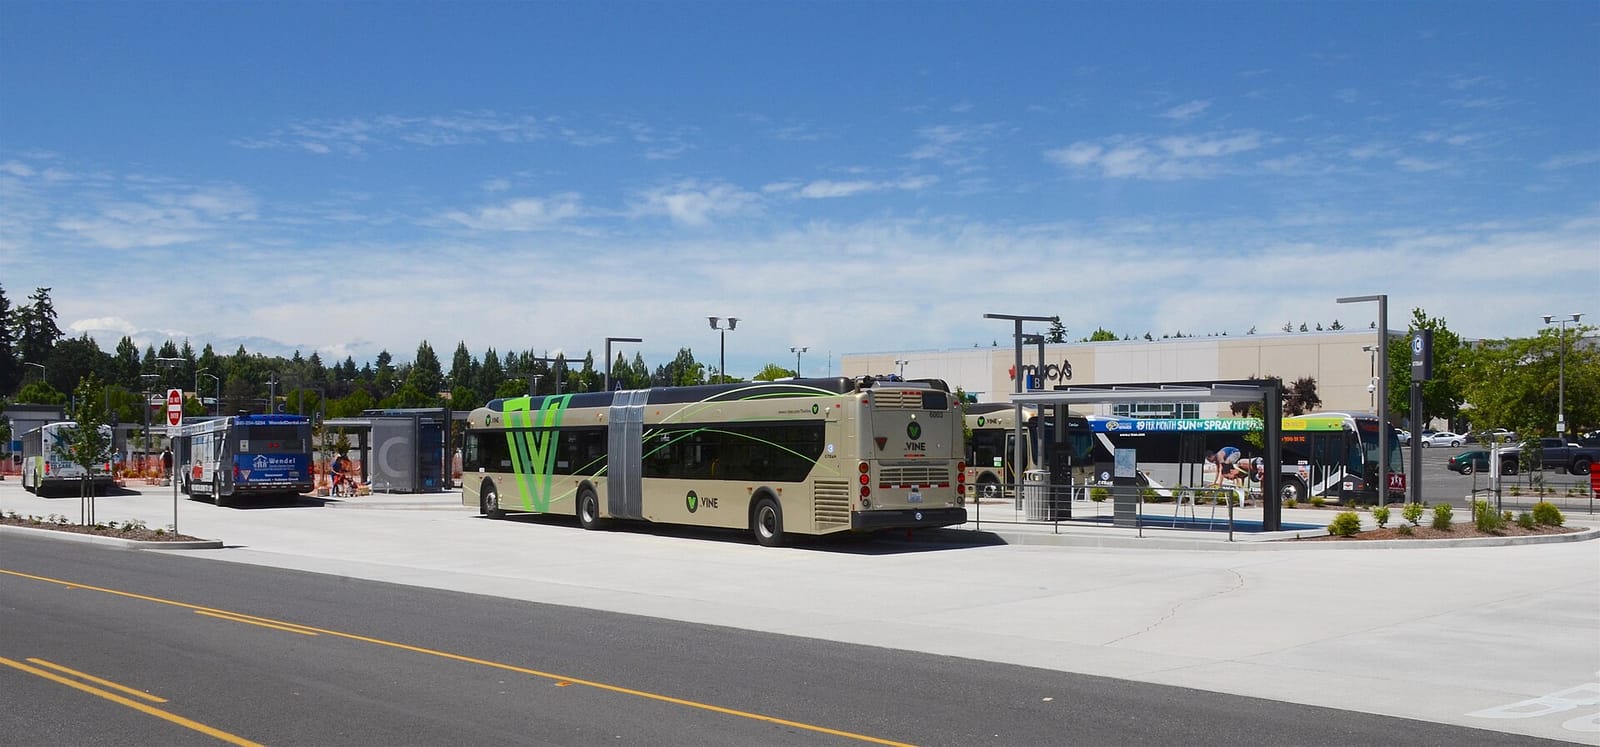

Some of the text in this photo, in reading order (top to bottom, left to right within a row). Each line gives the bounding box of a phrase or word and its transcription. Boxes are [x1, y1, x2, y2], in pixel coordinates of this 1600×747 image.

[1021, 359, 1073, 386] mcy's
[614, 380, 623, 391] A
[1034, 378, 1041, 389] B
[277, 403, 285, 413] C
[1155, 421, 1177, 431] MONTH
[1177, 420, 1196, 430] SUN
[1203, 420, 1233, 430] SPRAY
[905, 442, 926, 451] VINE
[701, 496, 719, 509] VINE
